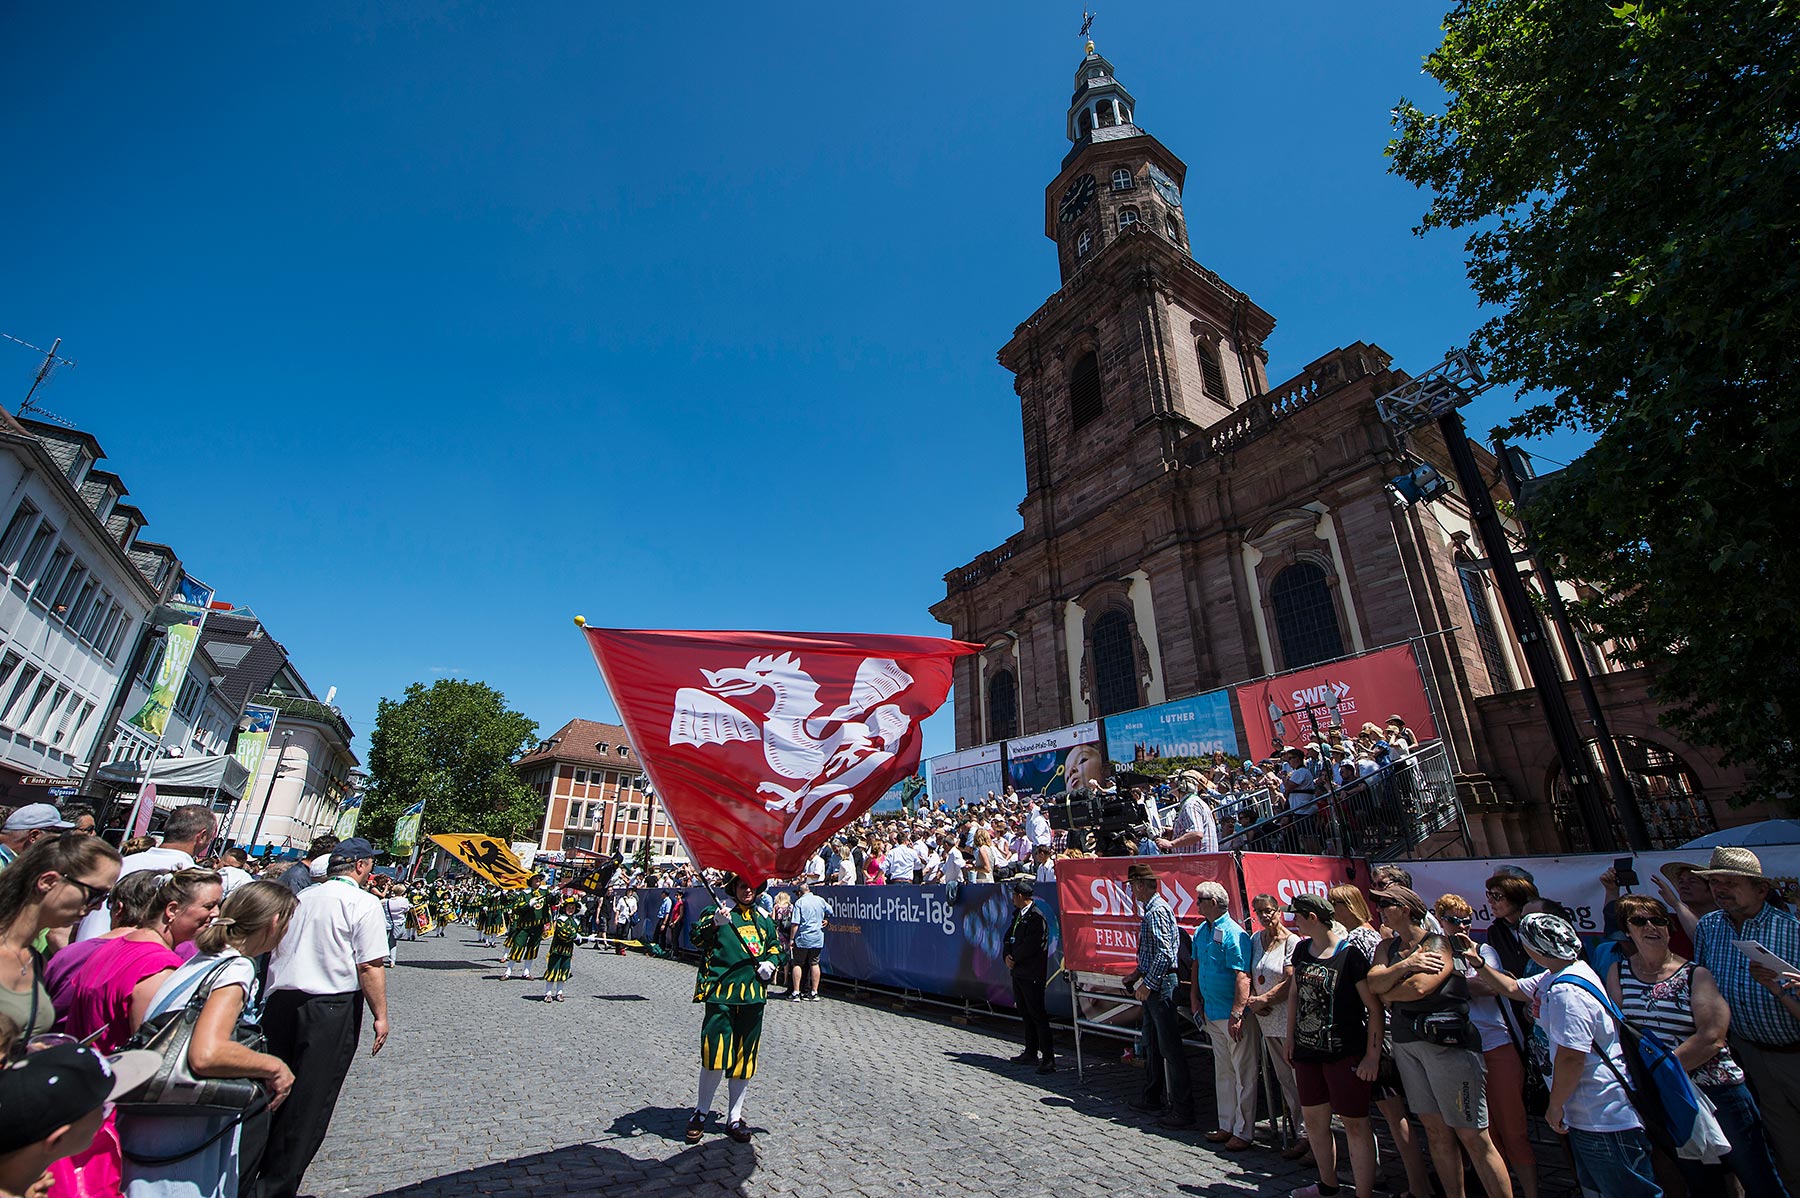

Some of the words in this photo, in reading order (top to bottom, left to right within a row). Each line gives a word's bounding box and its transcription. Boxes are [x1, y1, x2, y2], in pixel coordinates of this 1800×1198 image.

[1160, 712, 1195, 724] LUTHER
[1162, 740, 1225, 758] WORMS
[1115, 763, 1134, 772] DOM
[1090, 878, 1144, 917] SW
[827, 893, 956, 935] Rheinland-Pfalz-Tag
[1463, 1081, 1472, 1122] DEUTSCHLAND
